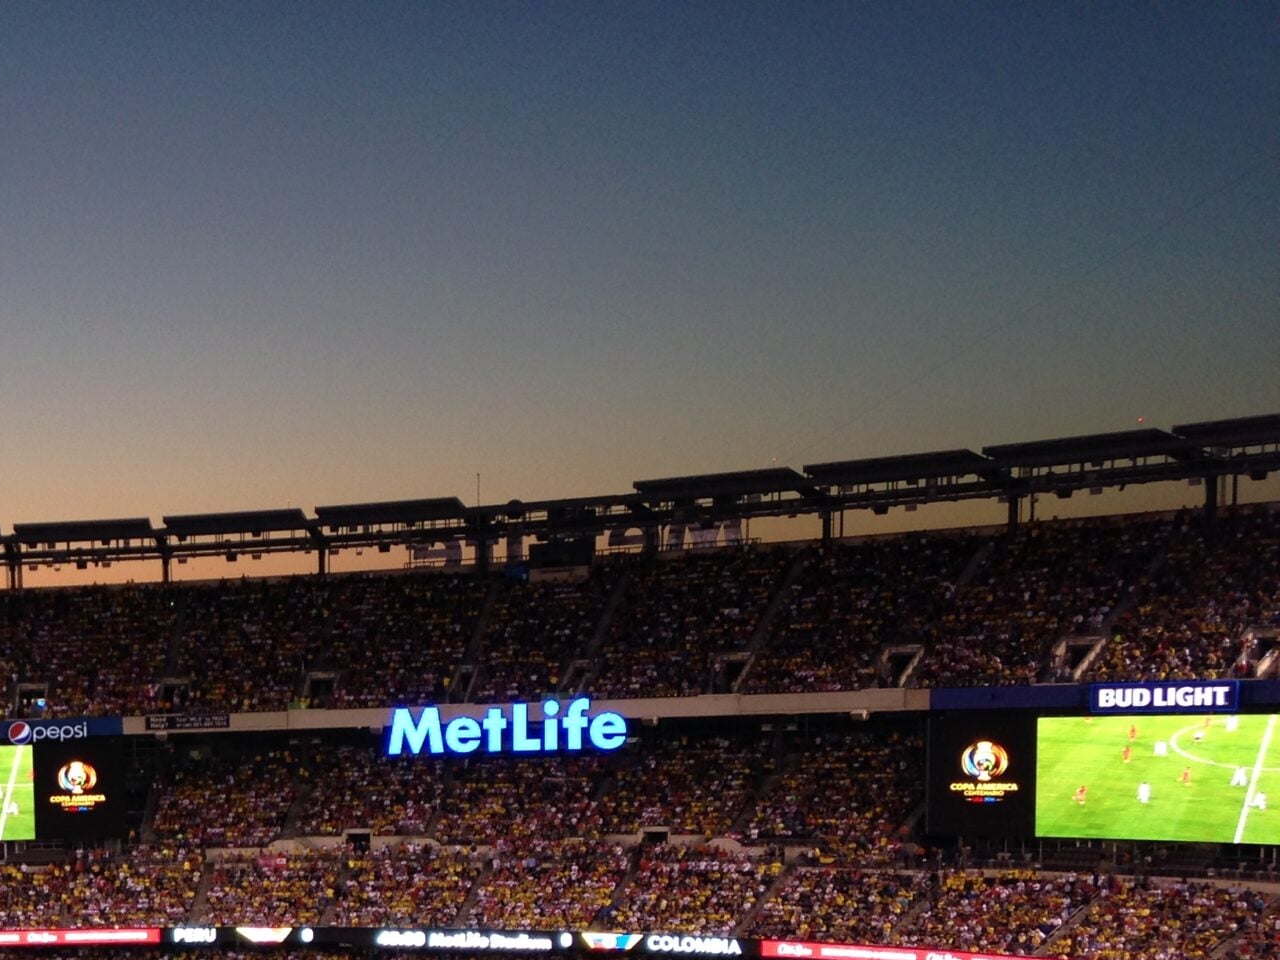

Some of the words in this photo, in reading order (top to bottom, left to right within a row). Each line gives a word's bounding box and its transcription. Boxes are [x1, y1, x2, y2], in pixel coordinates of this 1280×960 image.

[1099, 688, 1151, 707] BUD
[1153, 686, 1230, 706] LIGHT
[33, 722, 88, 742] pepsi
[388, 698, 627, 755] MetLife
[950, 783, 975, 791] COPA
[976, 783, 1018, 791] AMERICA
[174, 927, 217, 943] PERU
[647, 935, 743, 955] COLOMBIA
